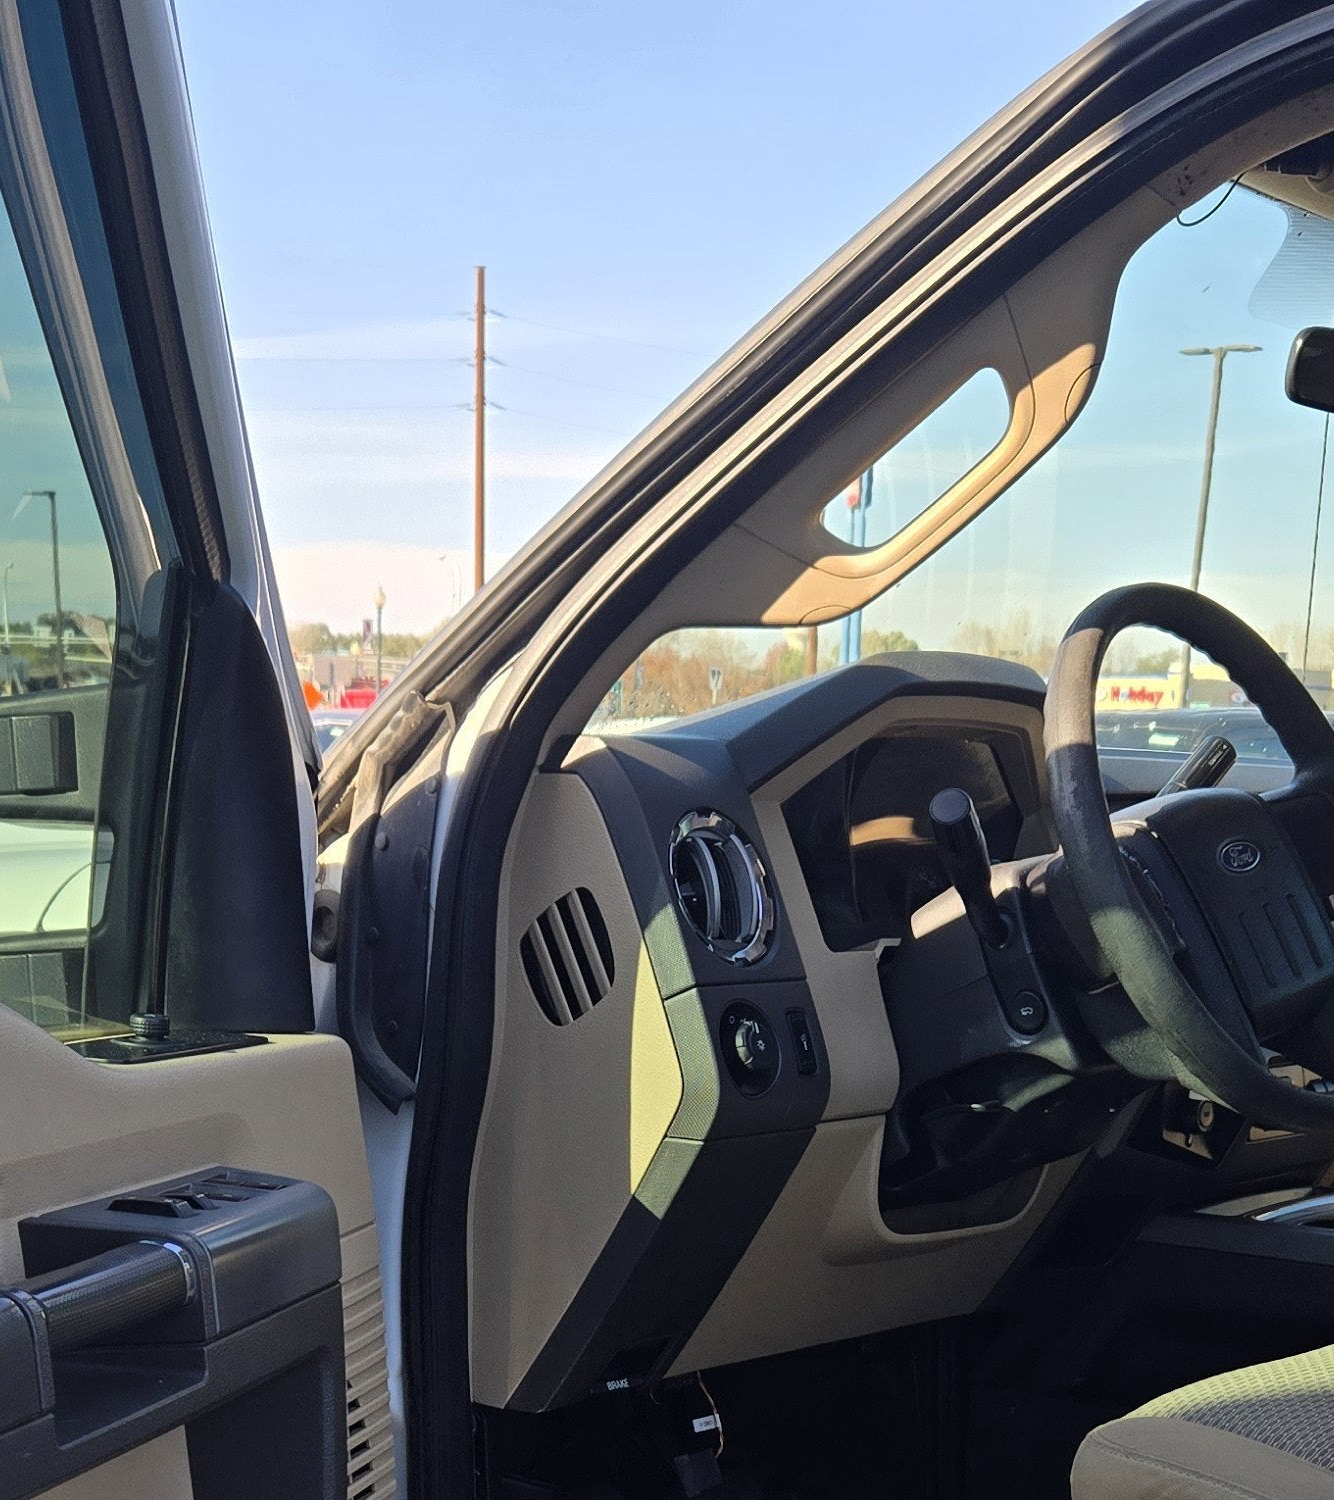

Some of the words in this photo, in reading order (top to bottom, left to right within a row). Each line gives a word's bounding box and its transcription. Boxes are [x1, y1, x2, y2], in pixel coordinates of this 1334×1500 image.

[1111, 686, 1164, 706] Holiday
[1229, 846, 1254, 867] Ford
[606, 1378, 630, 1391] BRAKE
